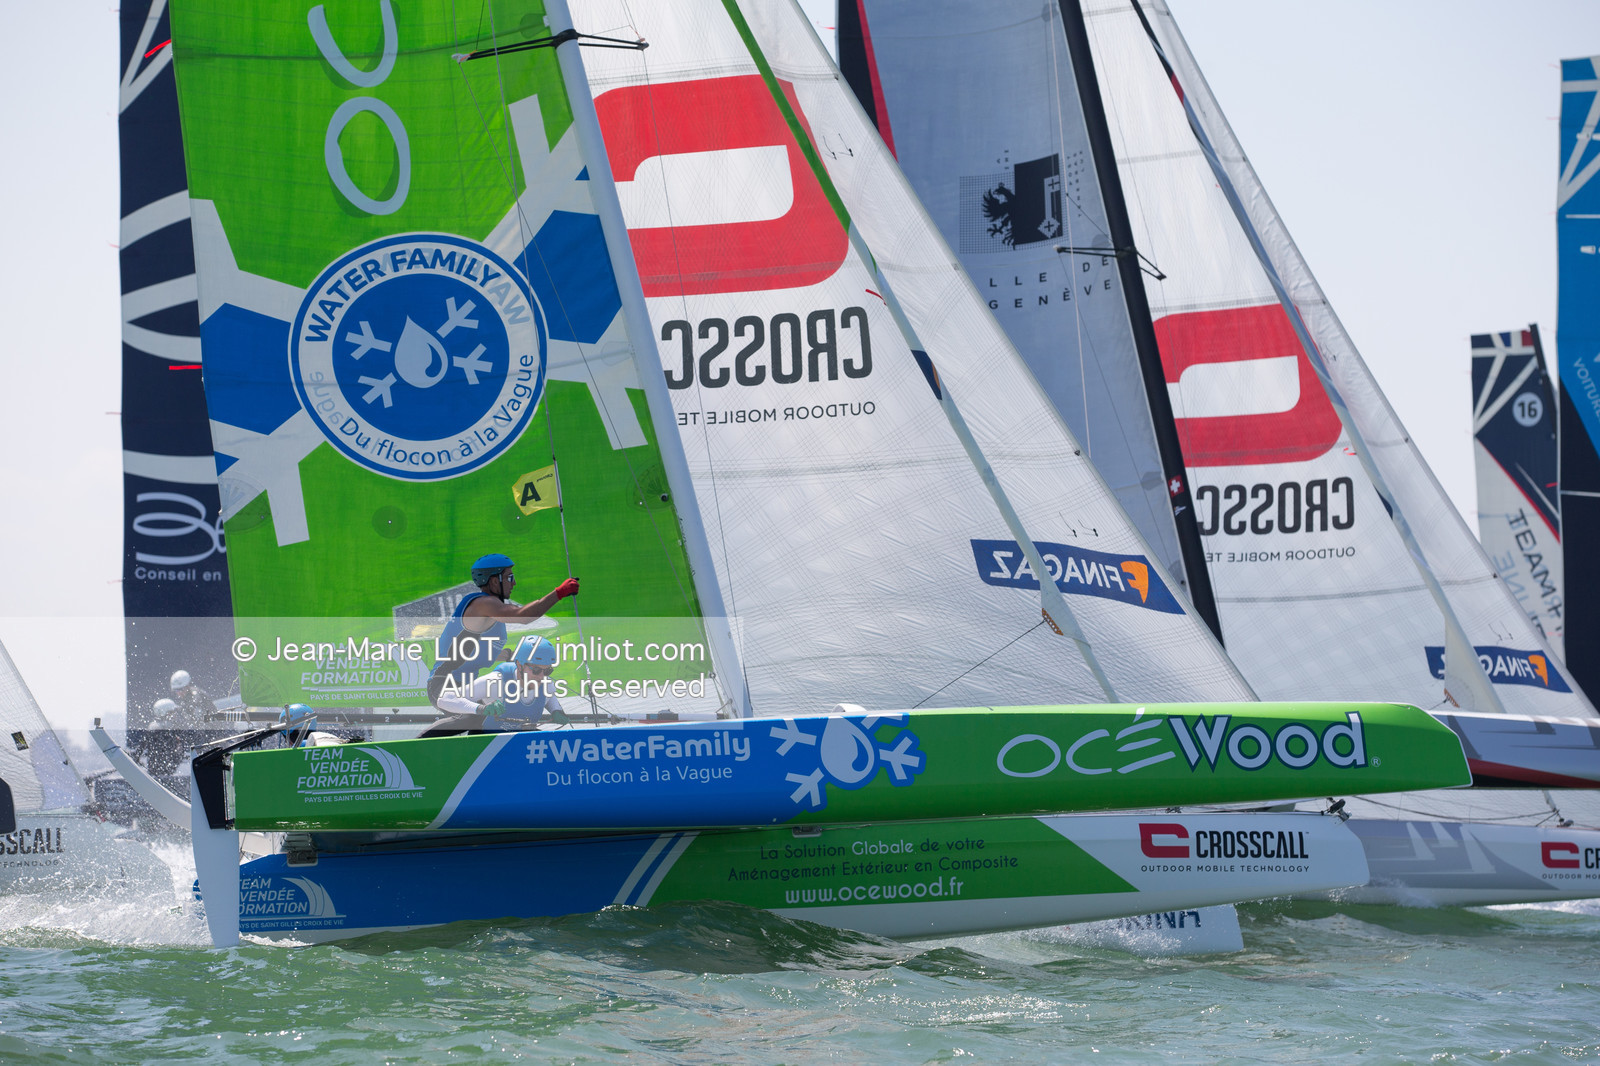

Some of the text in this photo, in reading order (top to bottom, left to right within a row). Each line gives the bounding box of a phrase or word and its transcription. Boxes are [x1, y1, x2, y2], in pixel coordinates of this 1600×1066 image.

[1082, 255, 1110, 273] DE
[304, 248, 501, 342] WATER FAMILY
[988, 279, 1112, 310] GENÈVE
[339, 353, 534, 466] Du flocon à la Vague
[1517, 400, 1539, 420] 16
[520, 481, 542, 507] A
[1509, 508, 1557, 598] TEAM
[134, 566, 222, 582] Conseil en
[300, 670, 399, 685] FORMATION
[310, 693, 330, 701] PAYS
[367, 691, 394, 700] GILLES
[395, 691, 419, 699] CROIX
[302, 748, 344, 761] TEAM
[525, 730, 751, 764] #WaterFamily
[310, 758, 370, 774] VENDÉE
[546, 765, 733, 786] Du flocon à la Vague
[296, 773, 384, 789] FORMATION
[760, 837, 985, 860] La Solution Globale de votre
[1195, 830, 1309, 859] CROSSCALL
[728, 855, 1019, 881] Aménagement Extérieur en Composite
[1141, 865, 1192, 873] OUTDOOR
[1240, 865, 1310, 873] TECHNOLOGY
[240, 887, 296, 902] VENDÉE
[785, 876, 964, 904] www.ocewood.fr
[239, 901, 308, 915] ORMATION
